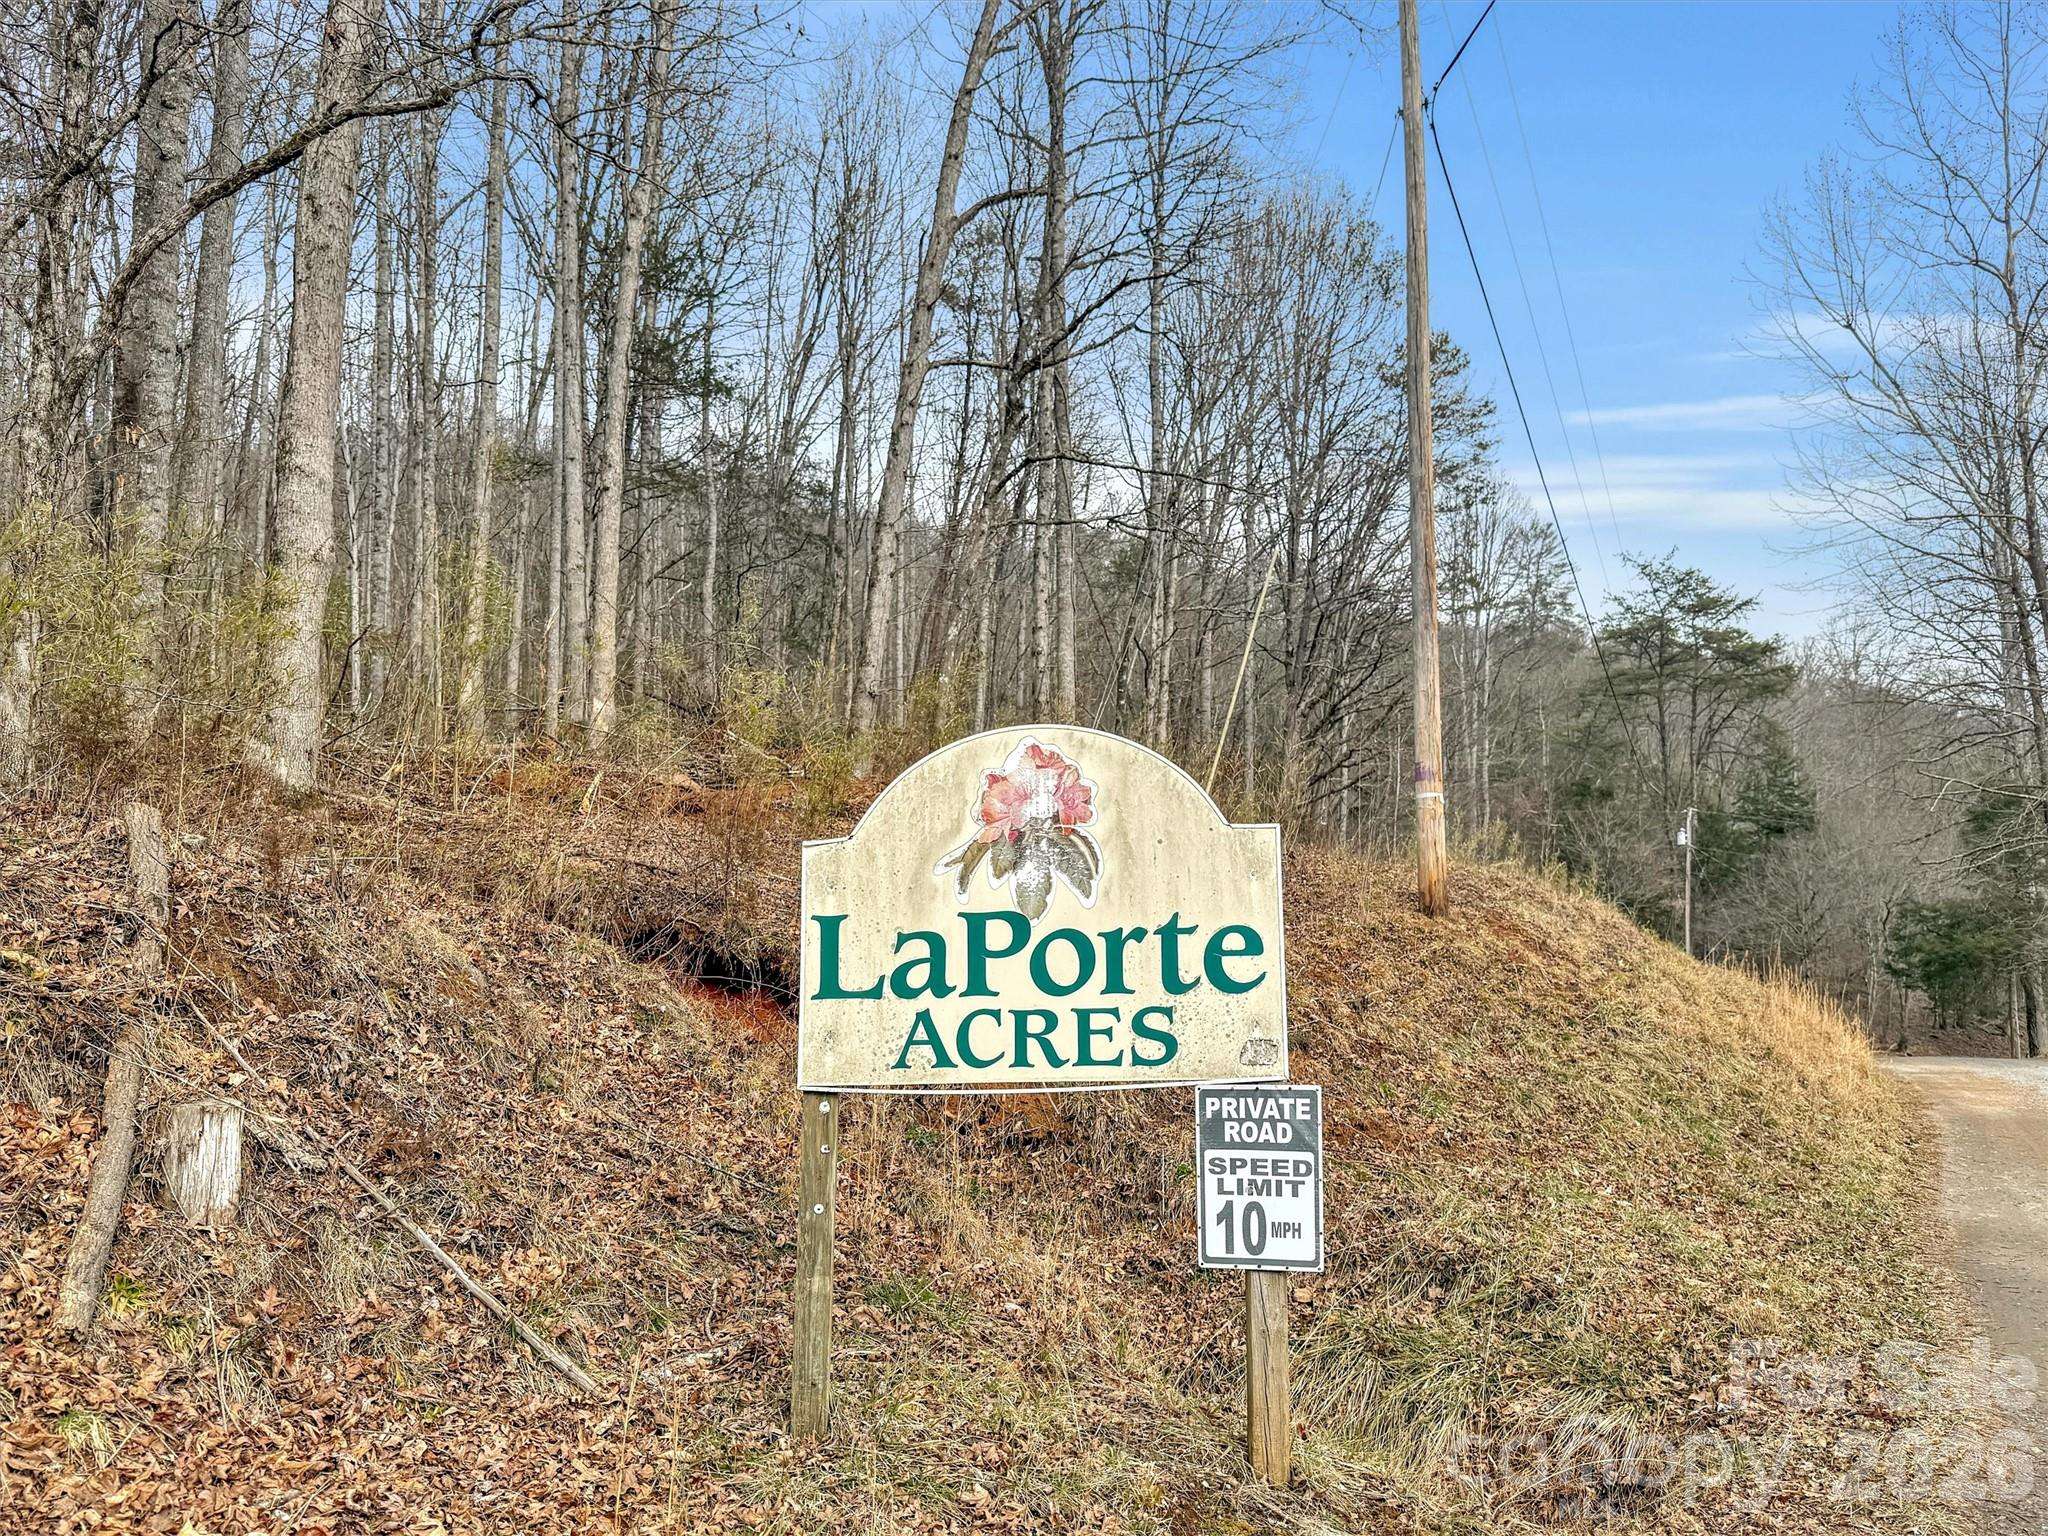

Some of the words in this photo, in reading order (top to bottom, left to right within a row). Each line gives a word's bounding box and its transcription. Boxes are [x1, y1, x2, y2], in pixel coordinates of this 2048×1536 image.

[811, 911, 1267, 1000] LaPorte
[891, 1005, 1180, 1069] ACRES
[1205, 1097, 1312, 1120] PRIVATE
[1224, 1121, 1293, 1144] ROAD
[1208, 1157, 1313, 1178] SPEED
[1217, 1178, 1306, 1198] LIMIT
[1216, 1199, 1267, 1256] 10
[1271, 1221, 1302, 1239] MPH
